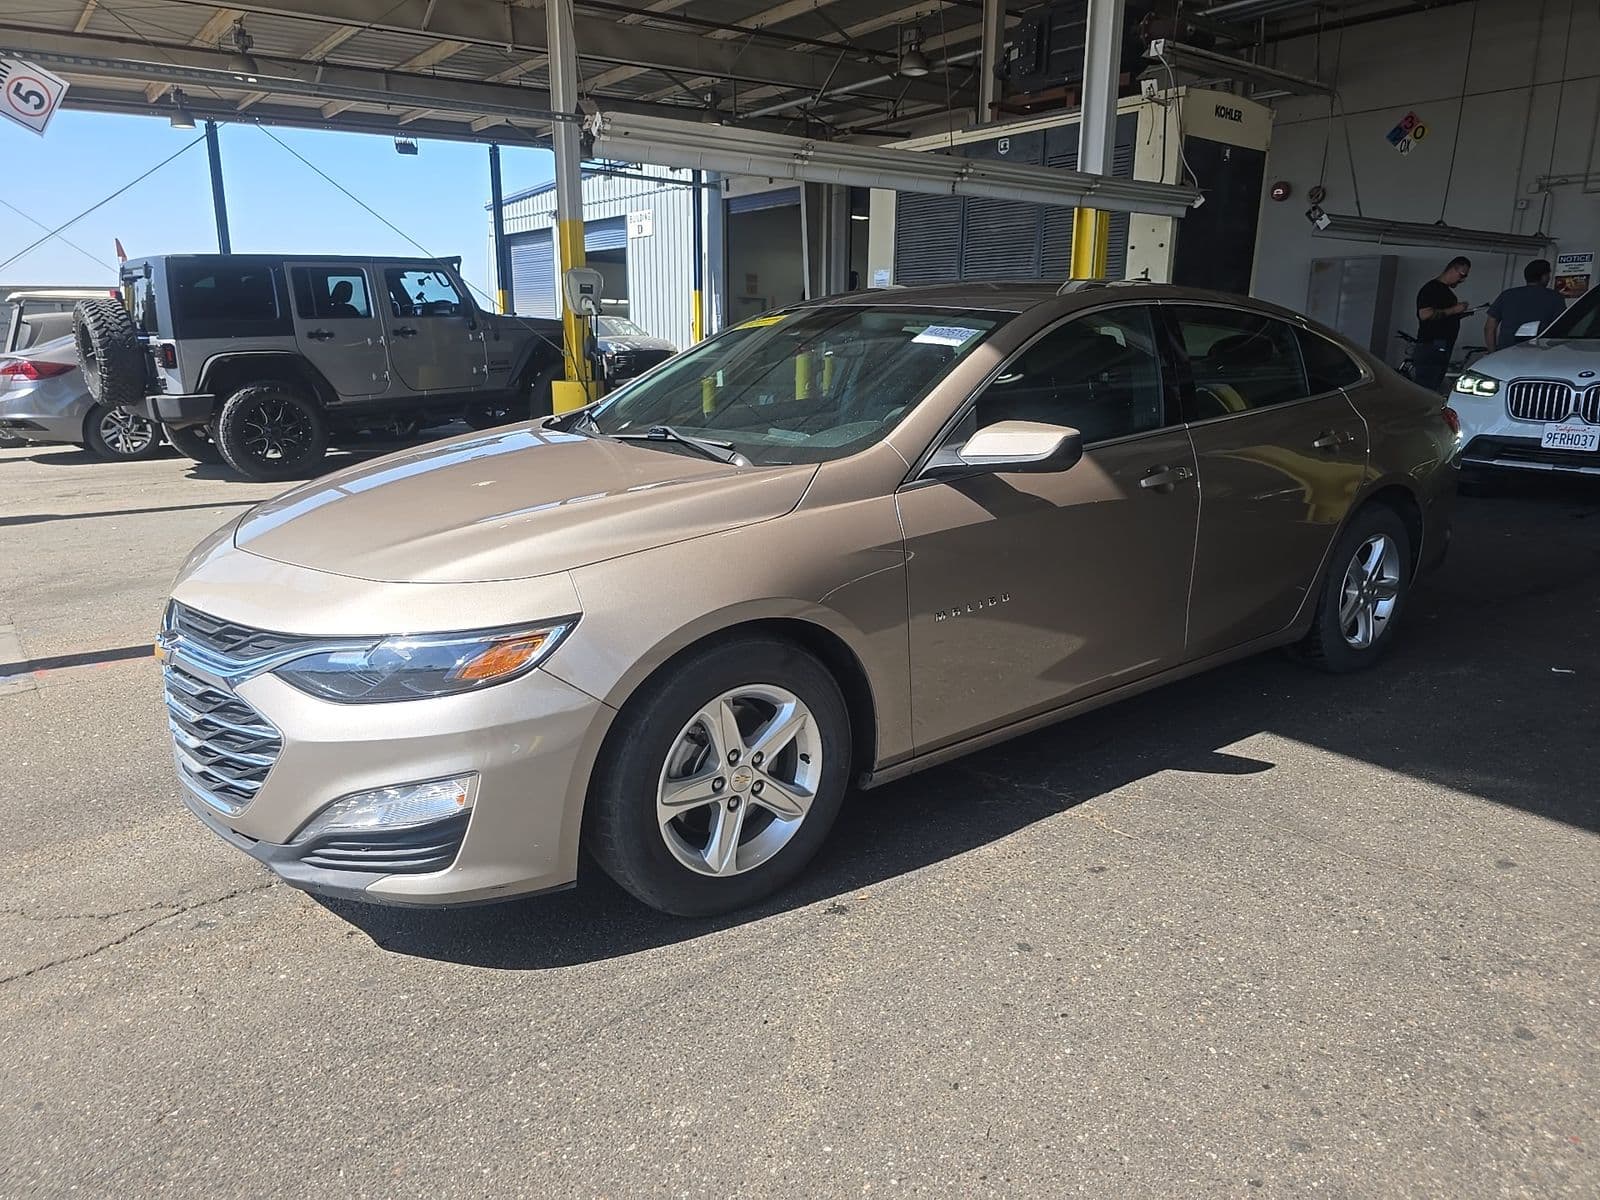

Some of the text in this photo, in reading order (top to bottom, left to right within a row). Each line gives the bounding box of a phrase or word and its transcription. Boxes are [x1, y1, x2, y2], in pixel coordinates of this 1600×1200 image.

[13, 82, 45, 110] 5
[1215, 104, 1242, 123] KOHLER
[1404, 115, 1414, 130] 3
[1413, 125, 1425, 140] 0
[637, 224, 643, 235] D
[1559, 254, 1591, 263] NOTICE
[1545, 432, 1596, 448] 9FRH037
[935, 593, 1010, 622] MALIBU
